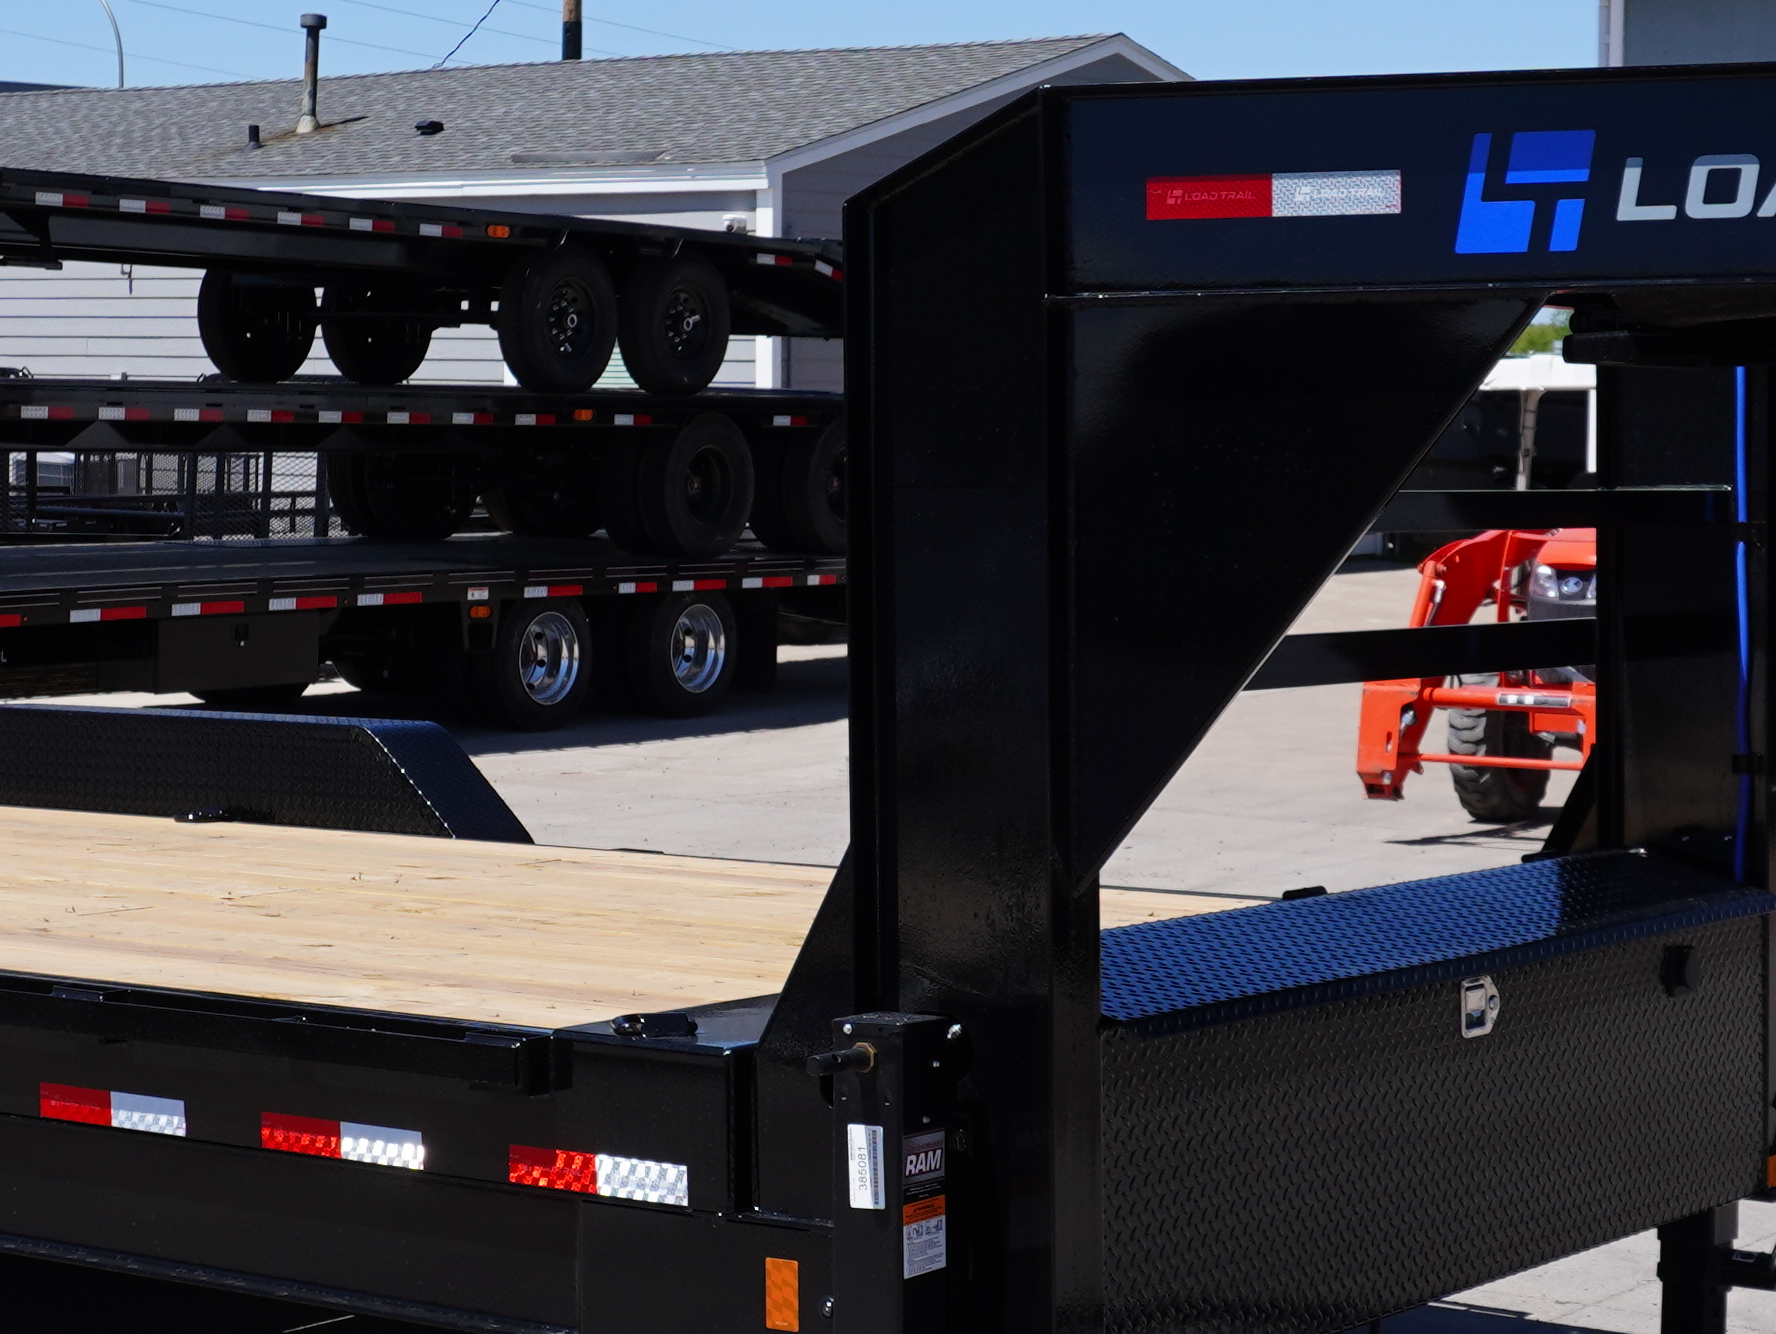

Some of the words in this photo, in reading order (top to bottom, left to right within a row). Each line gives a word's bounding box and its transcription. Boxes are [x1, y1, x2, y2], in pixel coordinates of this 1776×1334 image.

[1184, 190, 1219, 201] LOAD
[1221, 190, 1256, 200] TRAIL
[857, 1146, 868, 1191] 385081
[905, 1148, 942, 1177] RAM
